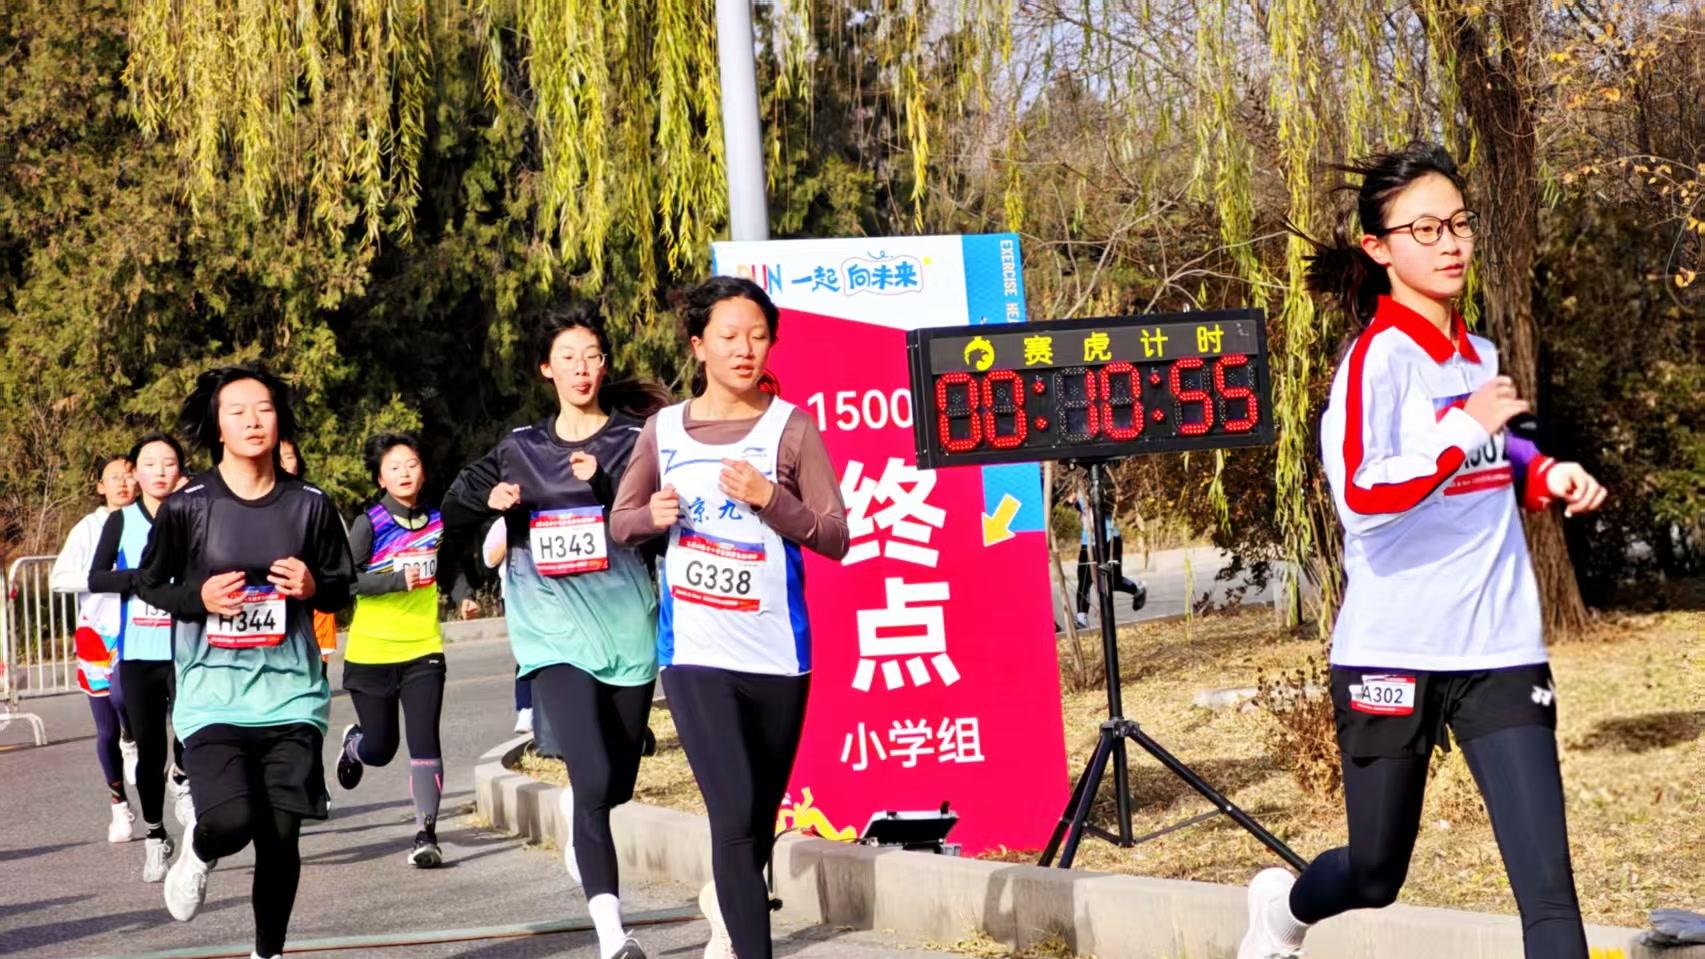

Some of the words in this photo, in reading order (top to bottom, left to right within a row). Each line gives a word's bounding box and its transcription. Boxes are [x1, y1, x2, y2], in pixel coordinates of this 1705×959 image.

[1001, 240, 1018, 296] EXERCISE
[1024, 324, 1224, 366] 赛虎计时
[935, 353, 1259, 452] 00:10:55
[539, 532, 596, 559] H343
[686, 560, 751, 595] G338
[839, 457, 961, 692] 终点
[218, 609, 276, 632] H344
[1361, 685, 1403, 704] A302
[840, 717, 984, 771] 小学组
